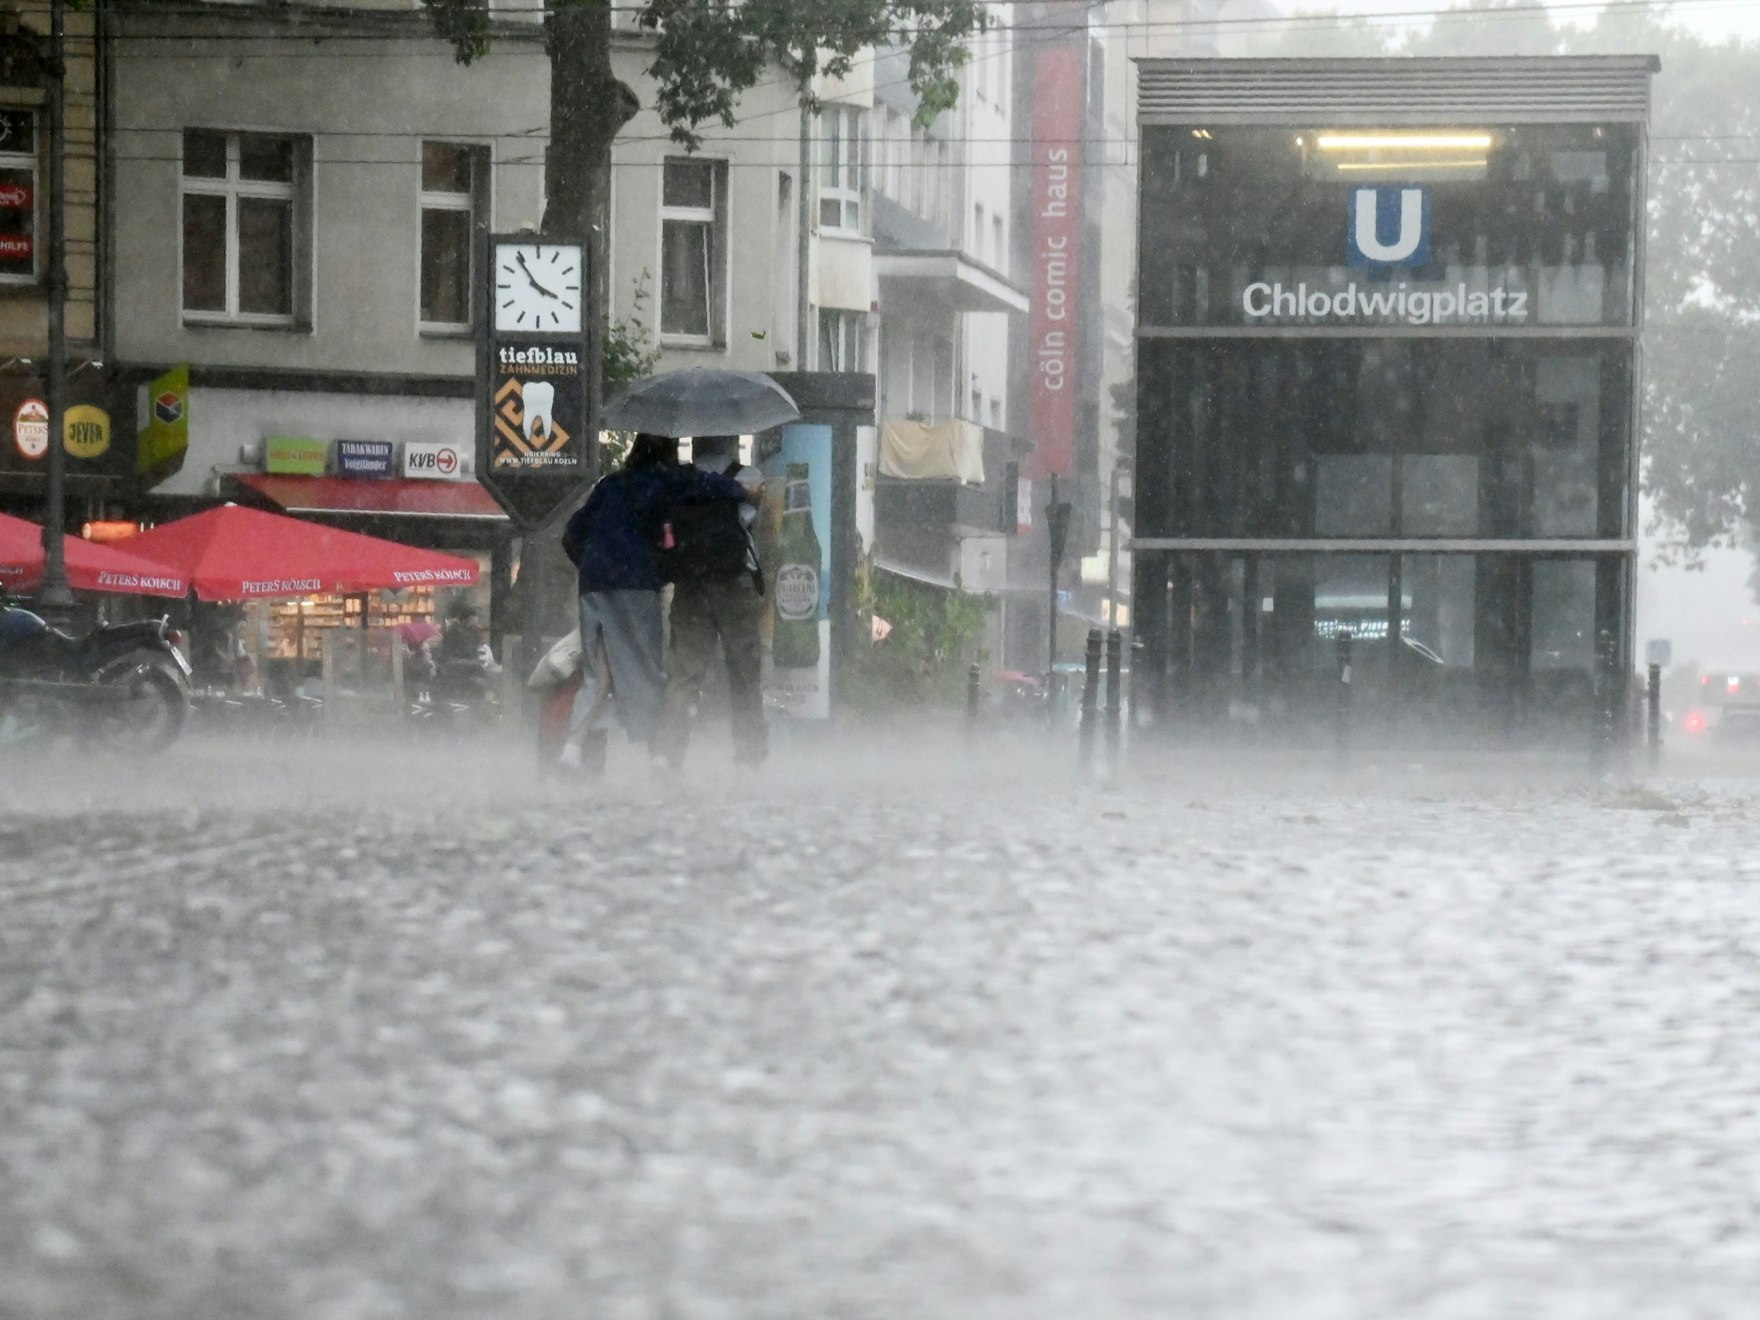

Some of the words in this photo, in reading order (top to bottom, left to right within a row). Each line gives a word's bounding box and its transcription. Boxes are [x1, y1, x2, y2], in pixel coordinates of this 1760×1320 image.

[1042, 148, 1068, 217] haus
[1355, 189, 1421, 261] U
[1042, 236, 1068, 320] comic
[1242, 281, 1528, 324] Chlodwigplatz
[499, 346, 578, 364] tiefblau
[1039, 331, 1065, 390] cöln
[500, 364, 578, 375] ZAHNMEDIZIN
[69, 422, 102, 443] JEVER
[341, 443, 389, 454] TABAKWAREN
[409, 452, 436, 468] KVB
[98, 571, 138, 586] PETERS
[394, 569, 433, 582] PETERS
[242, 580, 280, 593] PETERS
